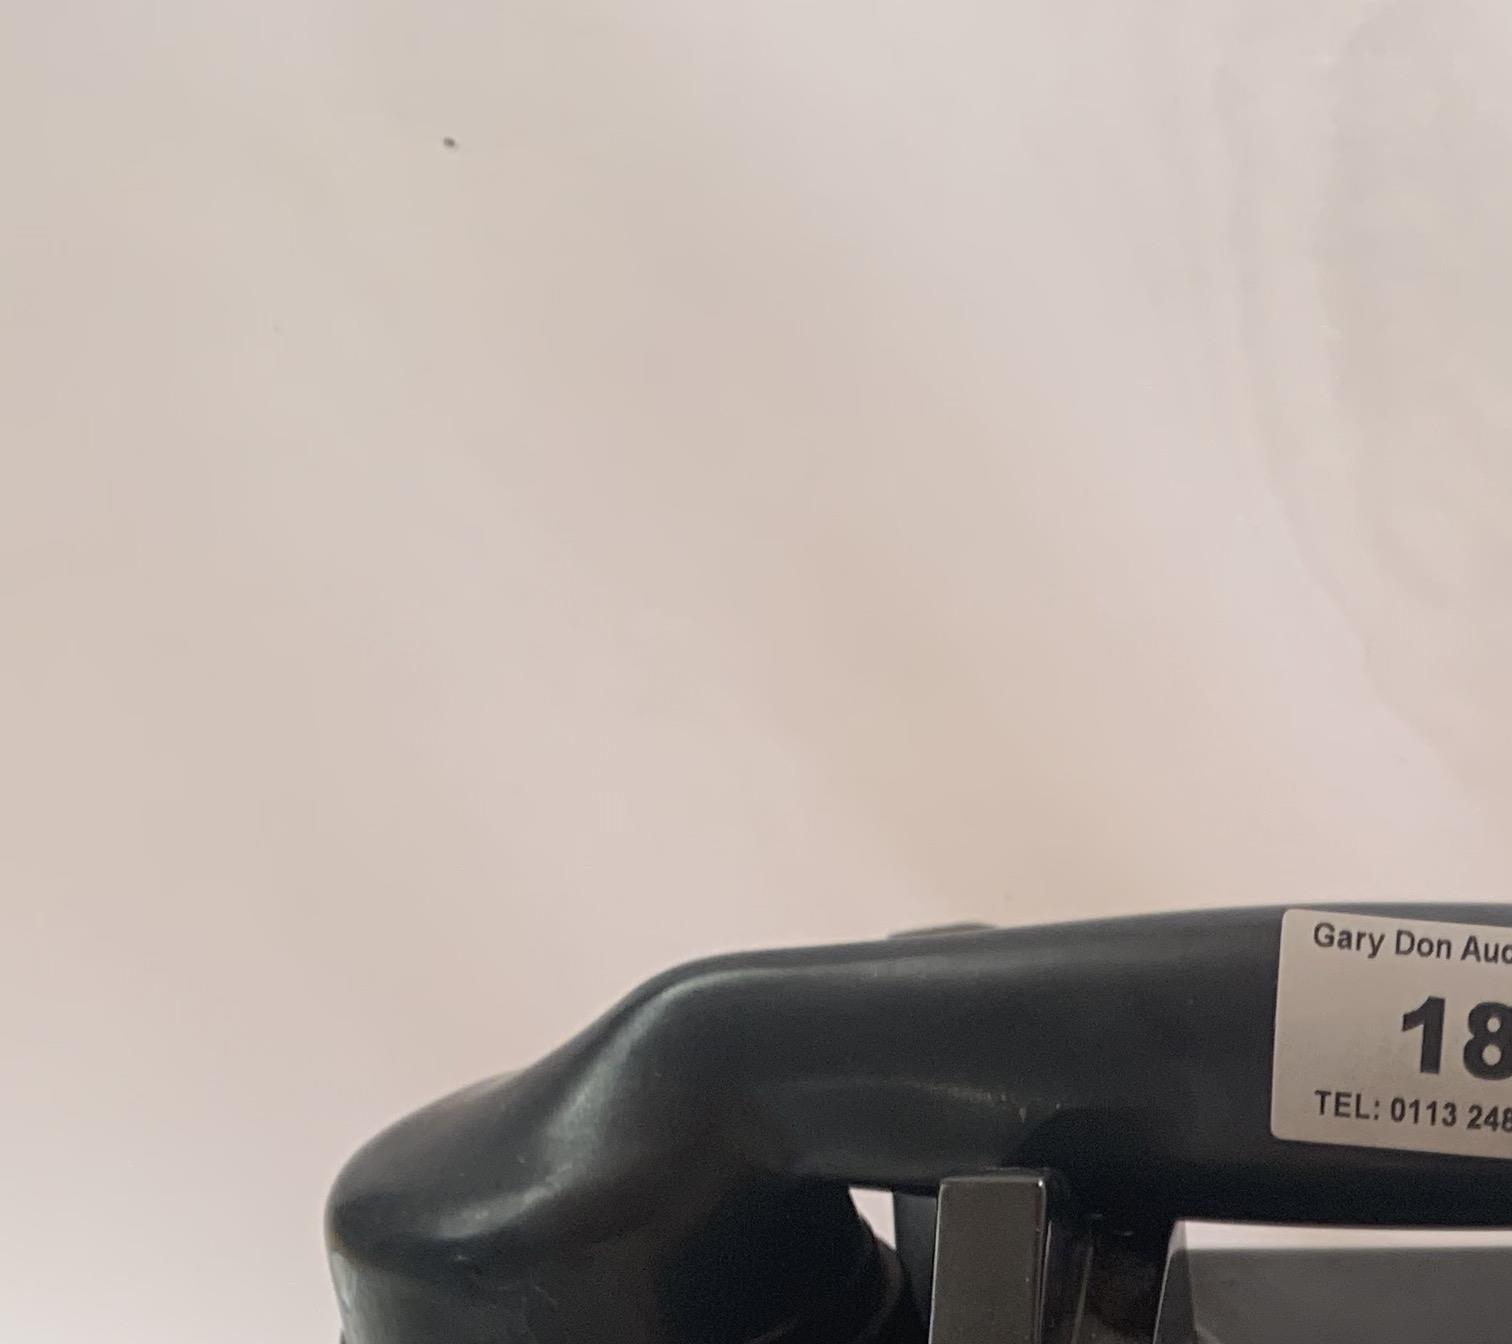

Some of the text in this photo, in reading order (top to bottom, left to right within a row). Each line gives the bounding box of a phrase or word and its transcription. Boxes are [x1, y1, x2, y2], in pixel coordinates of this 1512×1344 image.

[1313, 922, 1385, 959] Gary
[1394, 929, 1452, 960] Don
[1313, 1089, 1380, 1121] TEL:
[1390, 1097, 1457, 1127] 0113
